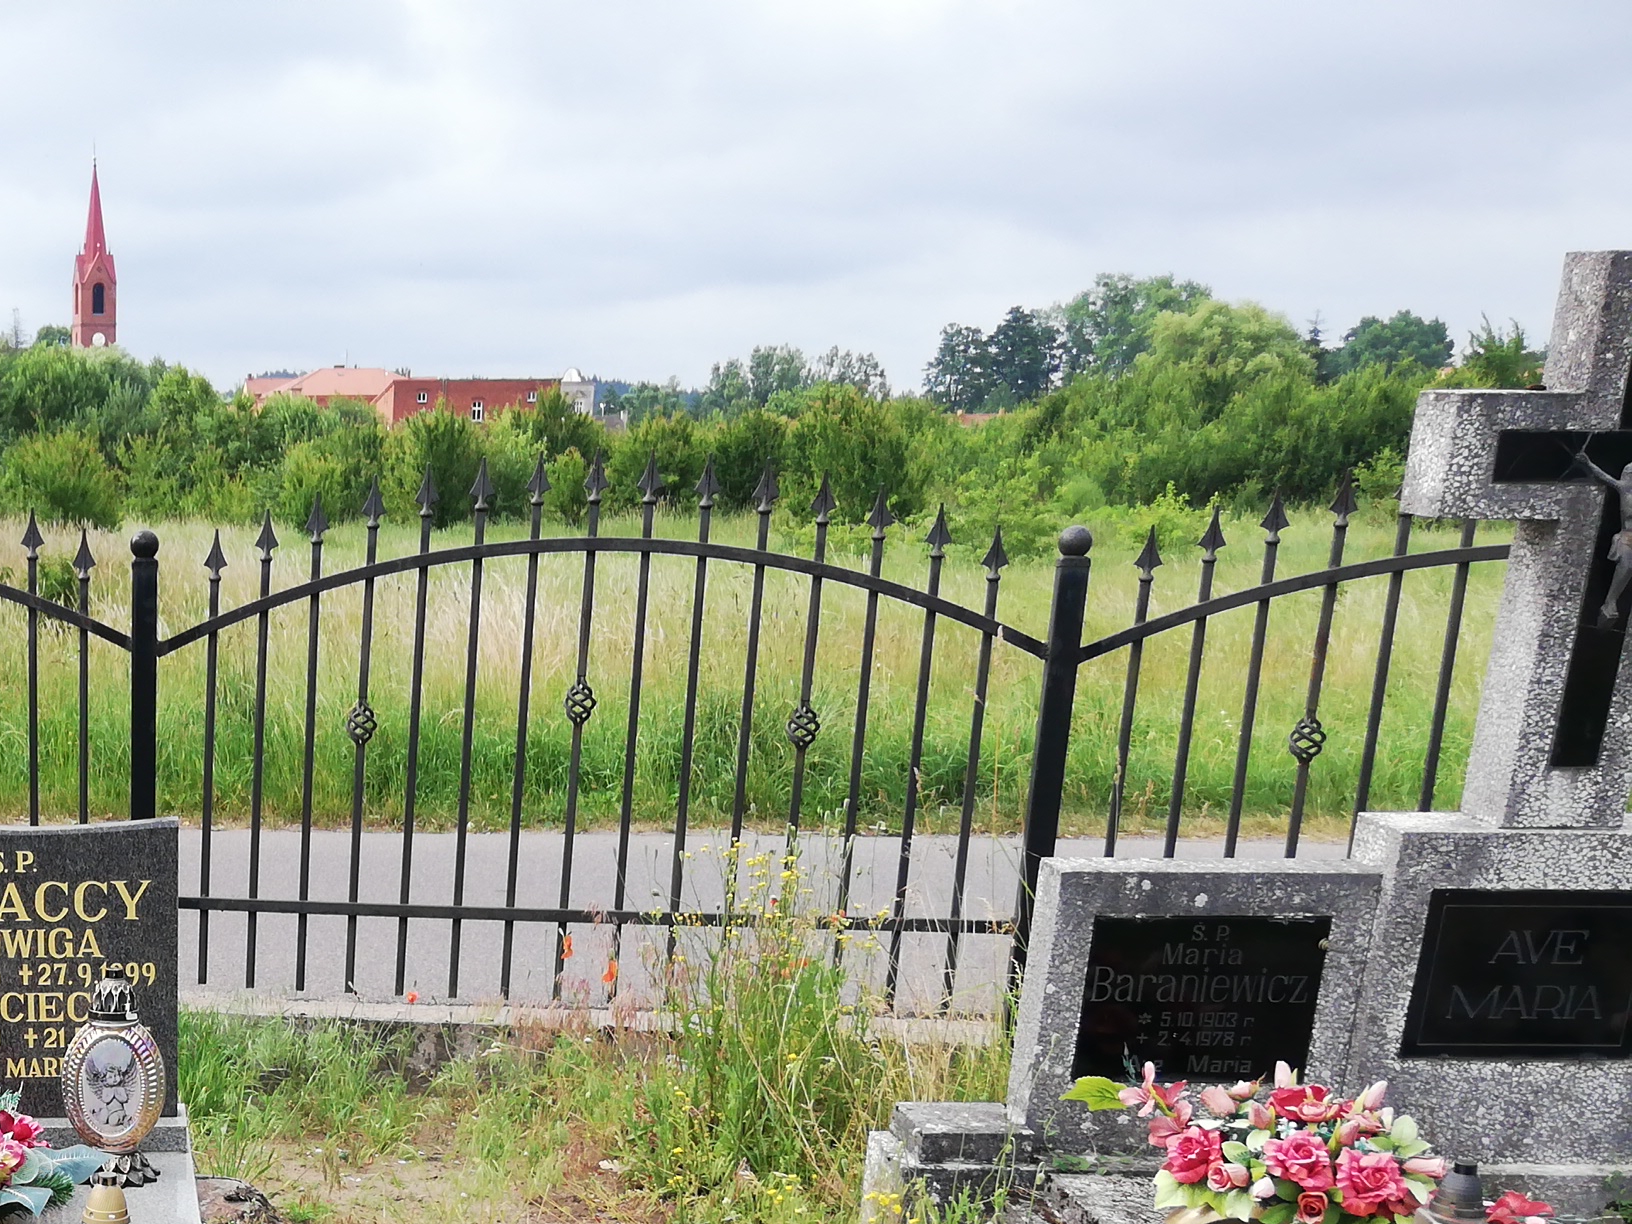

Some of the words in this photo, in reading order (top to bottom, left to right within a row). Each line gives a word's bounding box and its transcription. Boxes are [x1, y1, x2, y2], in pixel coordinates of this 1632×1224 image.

[1162, 943, 1243, 965] Maria
[1488, 929, 1590, 965] AVE
[38, 961, 156, 988] 27.9.199
[1090, 966, 1309, 1003] Baraniewicz
[1445, 985, 1603, 1020] MARIA
[5, 1057, 65, 1078] MARI
[1187, 1055, 1252, 1073] Maria
